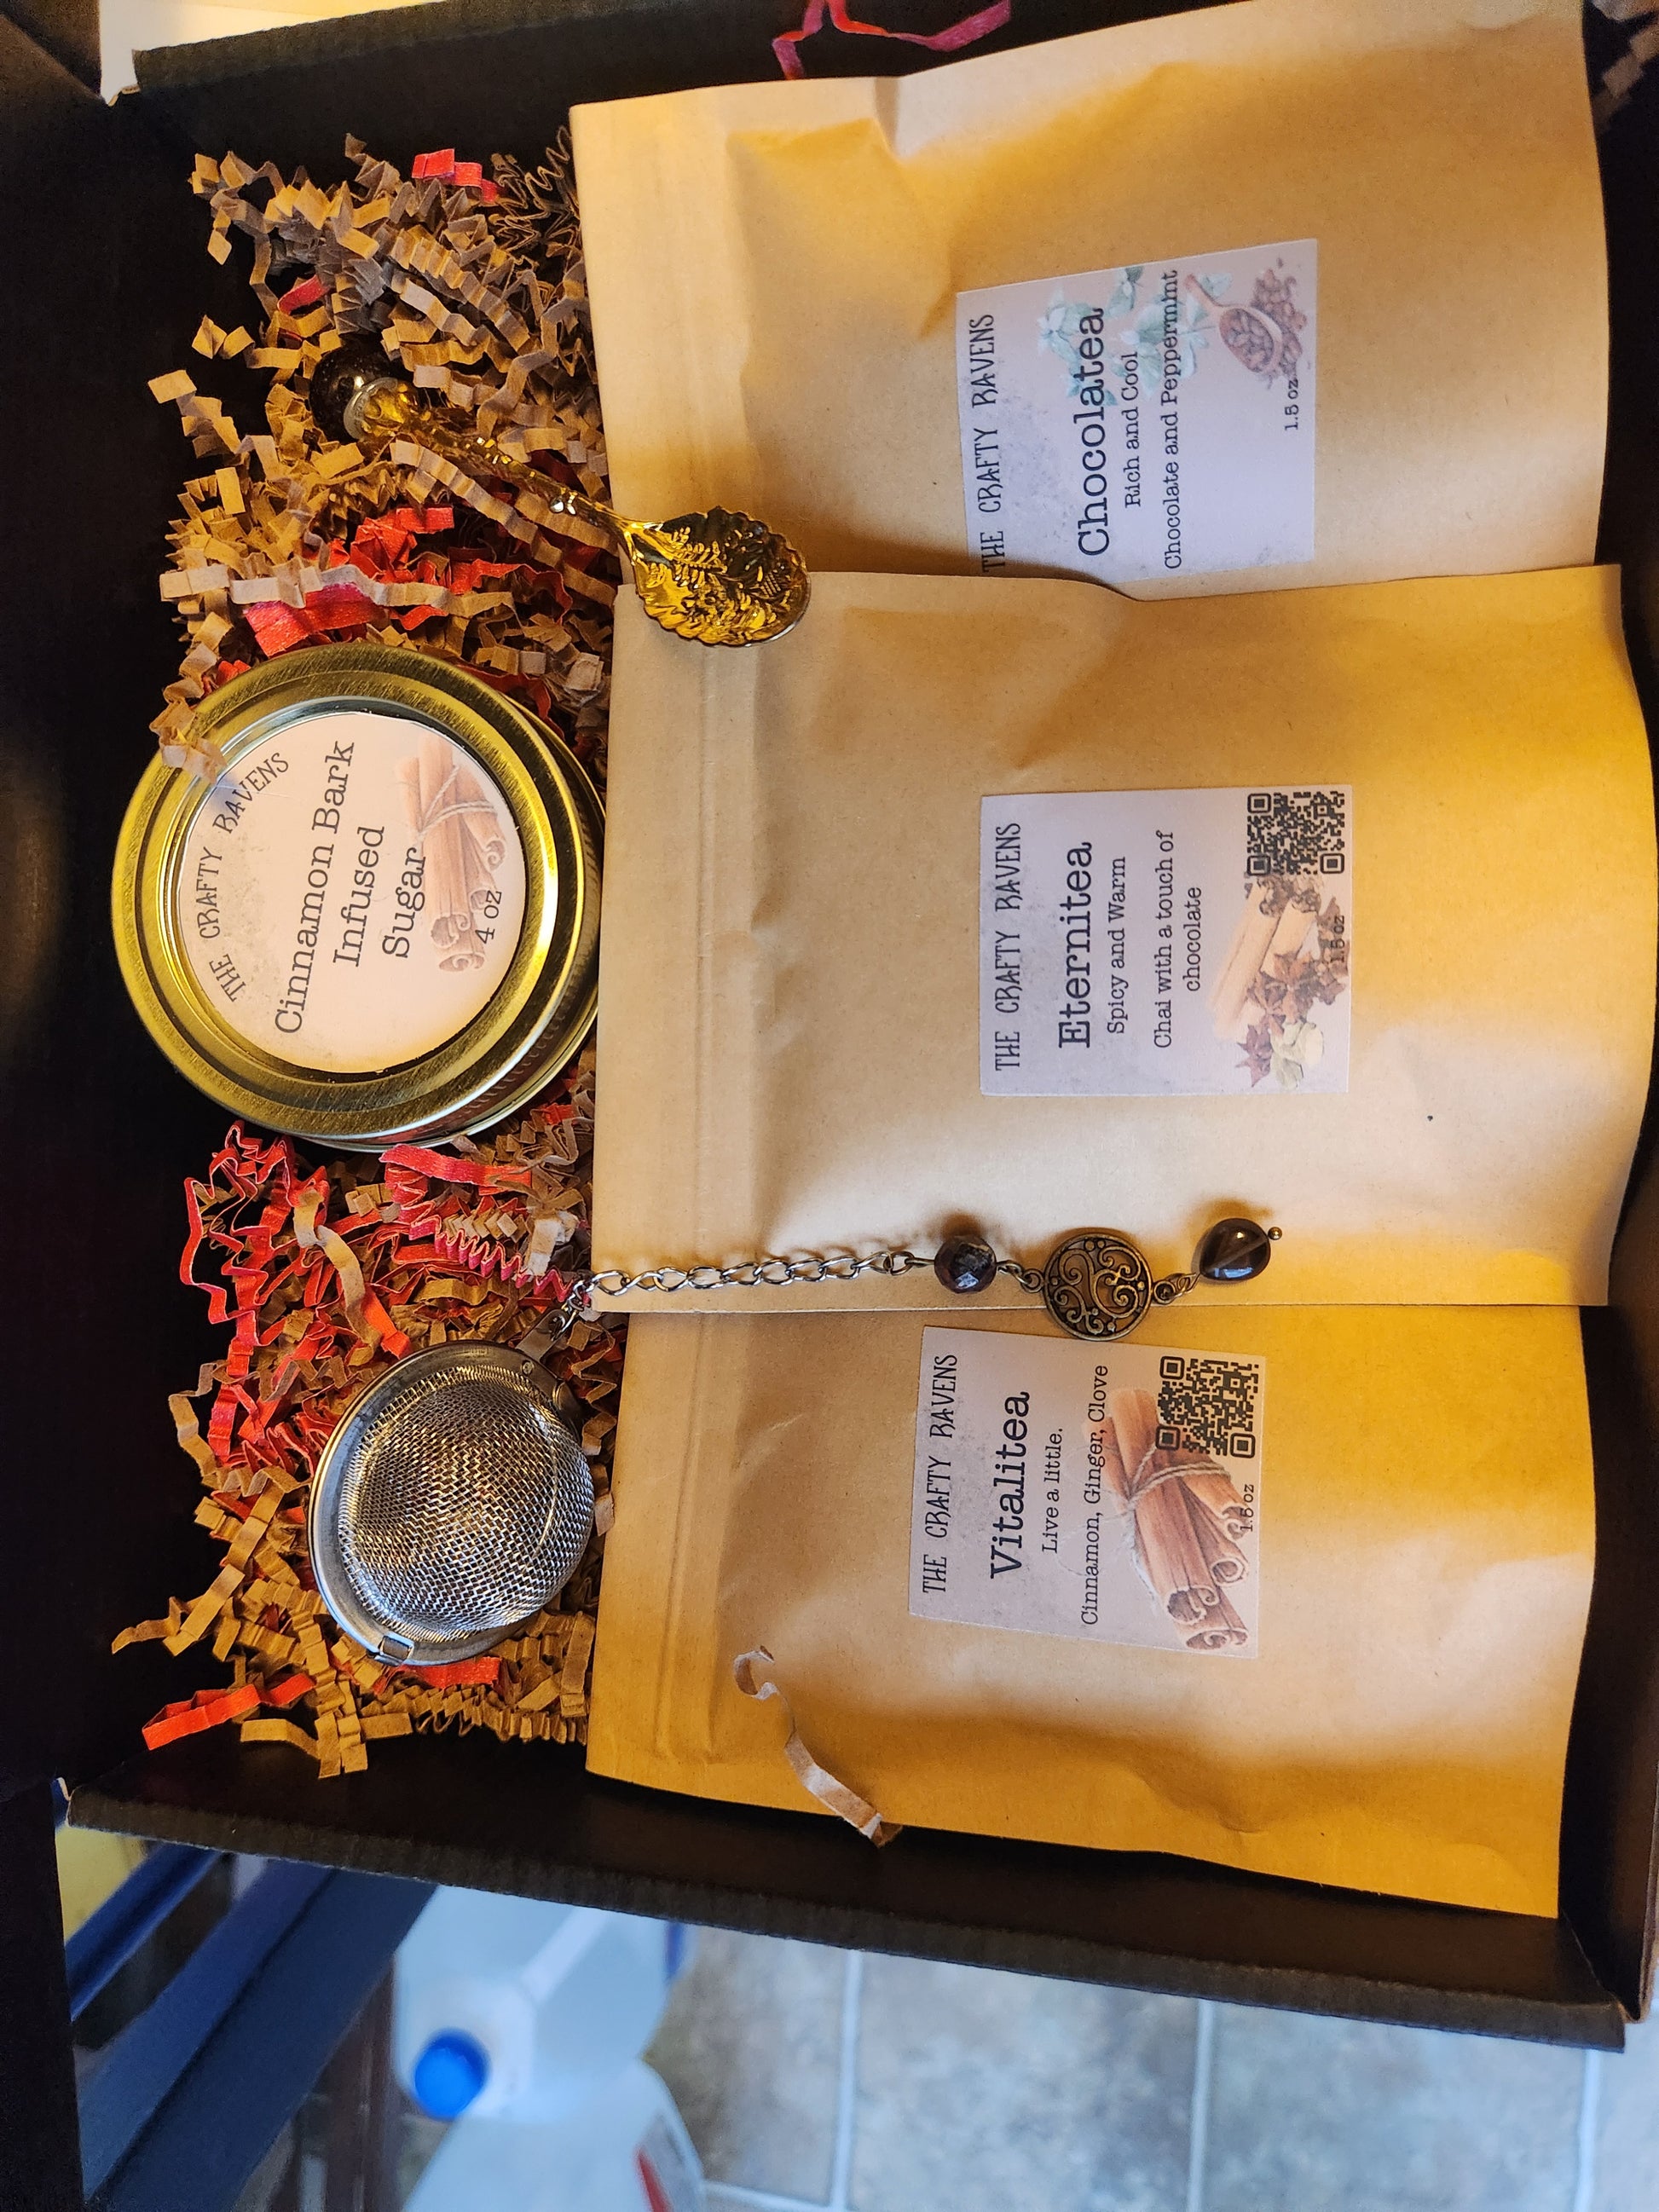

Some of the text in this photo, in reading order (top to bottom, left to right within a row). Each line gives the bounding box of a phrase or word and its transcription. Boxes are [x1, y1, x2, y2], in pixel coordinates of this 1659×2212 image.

[968, 315, 1005, 573] THE CRAFTY RAVENS
[1073, 308, 1110, 557] Chocolatea
[1120, 351, 1141, 509] Rich and Cool
[1160, 271, 1183, 569] Chocolate and Peppermint
[1284, 378, 1299, 430] 1.5 oz
[196, 753, 289, 1002] THE CRAFTY RAVENS
[275, 741, 355, 1034] Cinnamon Bark
[333, 826, 384, 967] Infused
[383, 847, 426, 958] Sugar
[475, 890, 503, 944] 4 oz
[995, 823, 1023, 1071] THE CRAFTY RAVENS
[1059, 841, 1092, 1049] Eternitea
[1107, 857, 1129, 1034] Spicy and Warm
[1153, 830, 1174, 1048] Chai with a touch of
[1182, 887, 1202, 991] chocolate
[1333, 915, 1345, 934] oz
[922, 1354, 958, 1594] THE CRAFTY RAVENS
[990, 1391, 1030, 1580] Vitalitea
[1042, 1428, 1063, 1554] Live a little.
[1081, 1366, 1108, 1625] Cinnamon, Ginger, Clove
[1240, 1484, 1254, 1533] 1.5 oz
